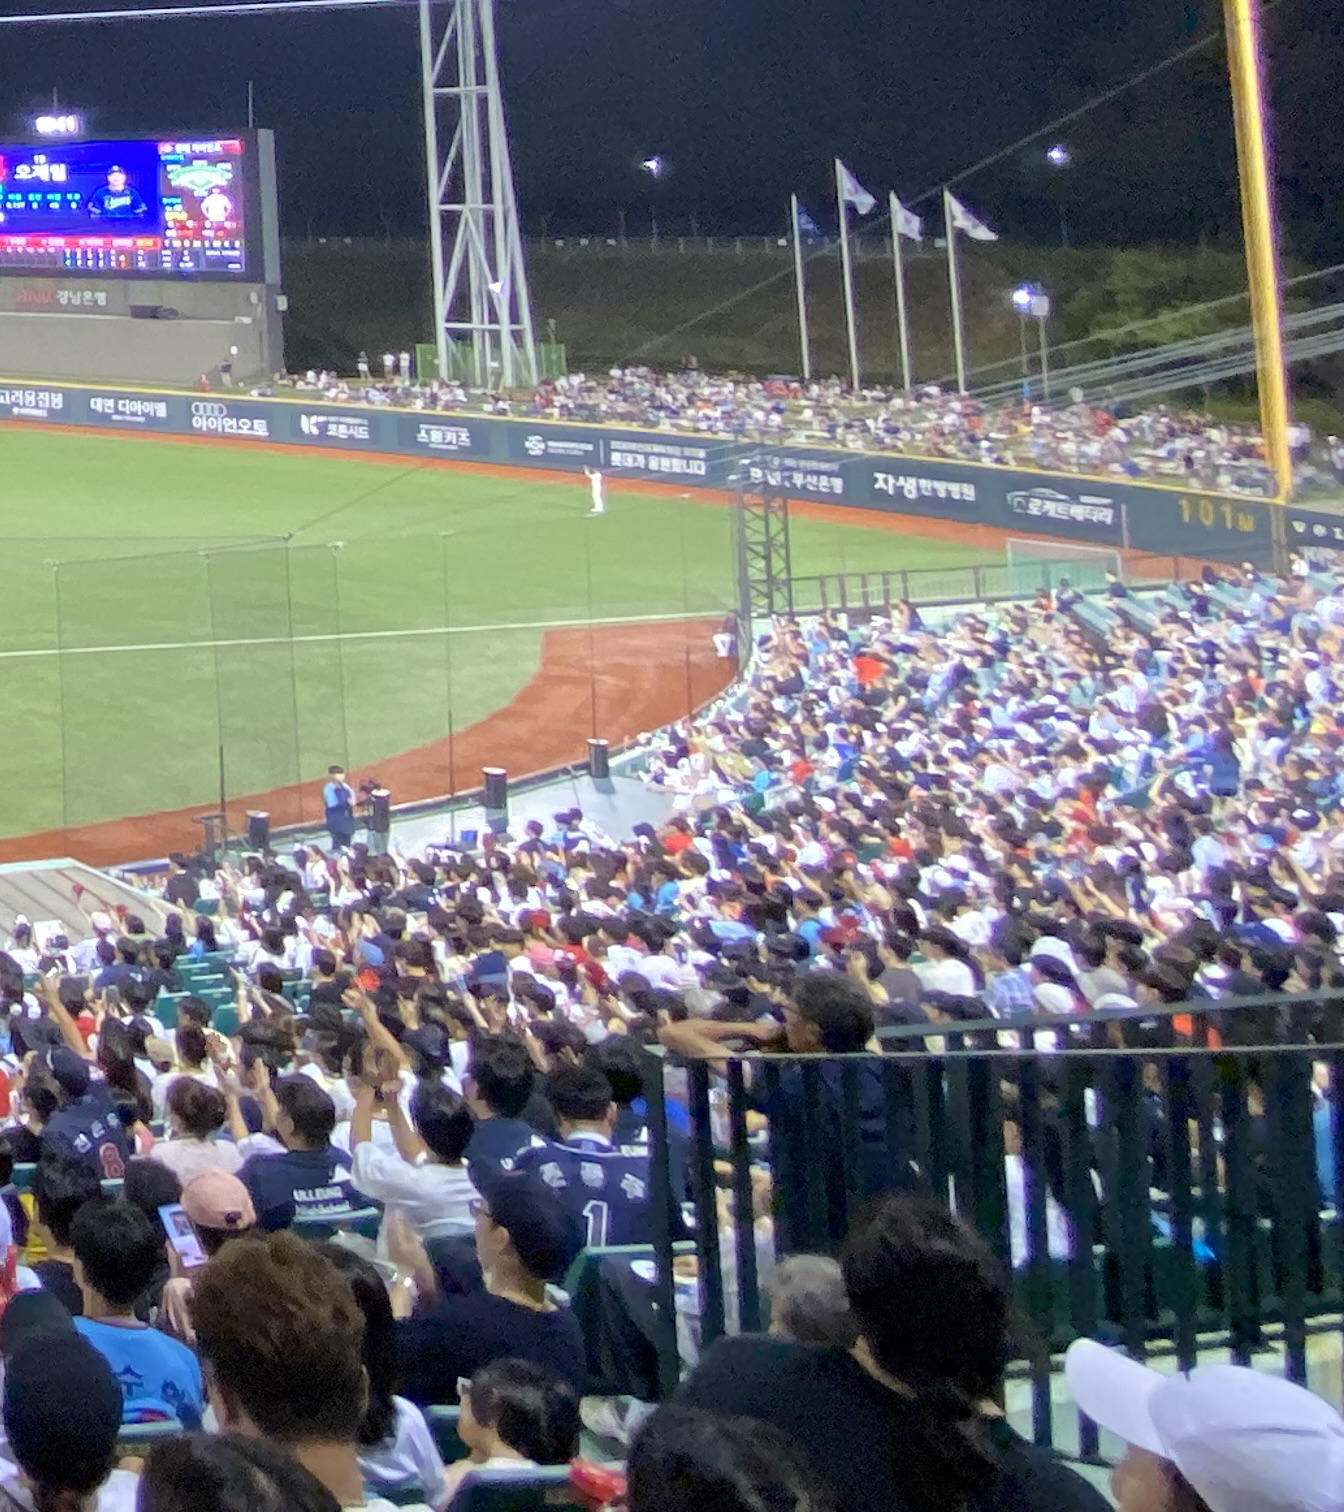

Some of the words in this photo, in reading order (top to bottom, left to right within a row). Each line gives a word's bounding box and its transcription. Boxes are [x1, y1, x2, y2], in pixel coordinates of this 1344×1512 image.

[57, 290, 107, 307] 경남은행
[90, 396, 114, 414] 대연
[118, 399, 168, 419] 디아이엘
[191, 416, 270, 437] 아이언오토
[793, 471, 844, 494] 부산은행
[873, 471, 976, 502] 자생한방병원
[1026, 496, 1114, 525] 로케트배터리
[99, 1142, 126, 1179] 8
[582, 1199, 609, 1248] 1
